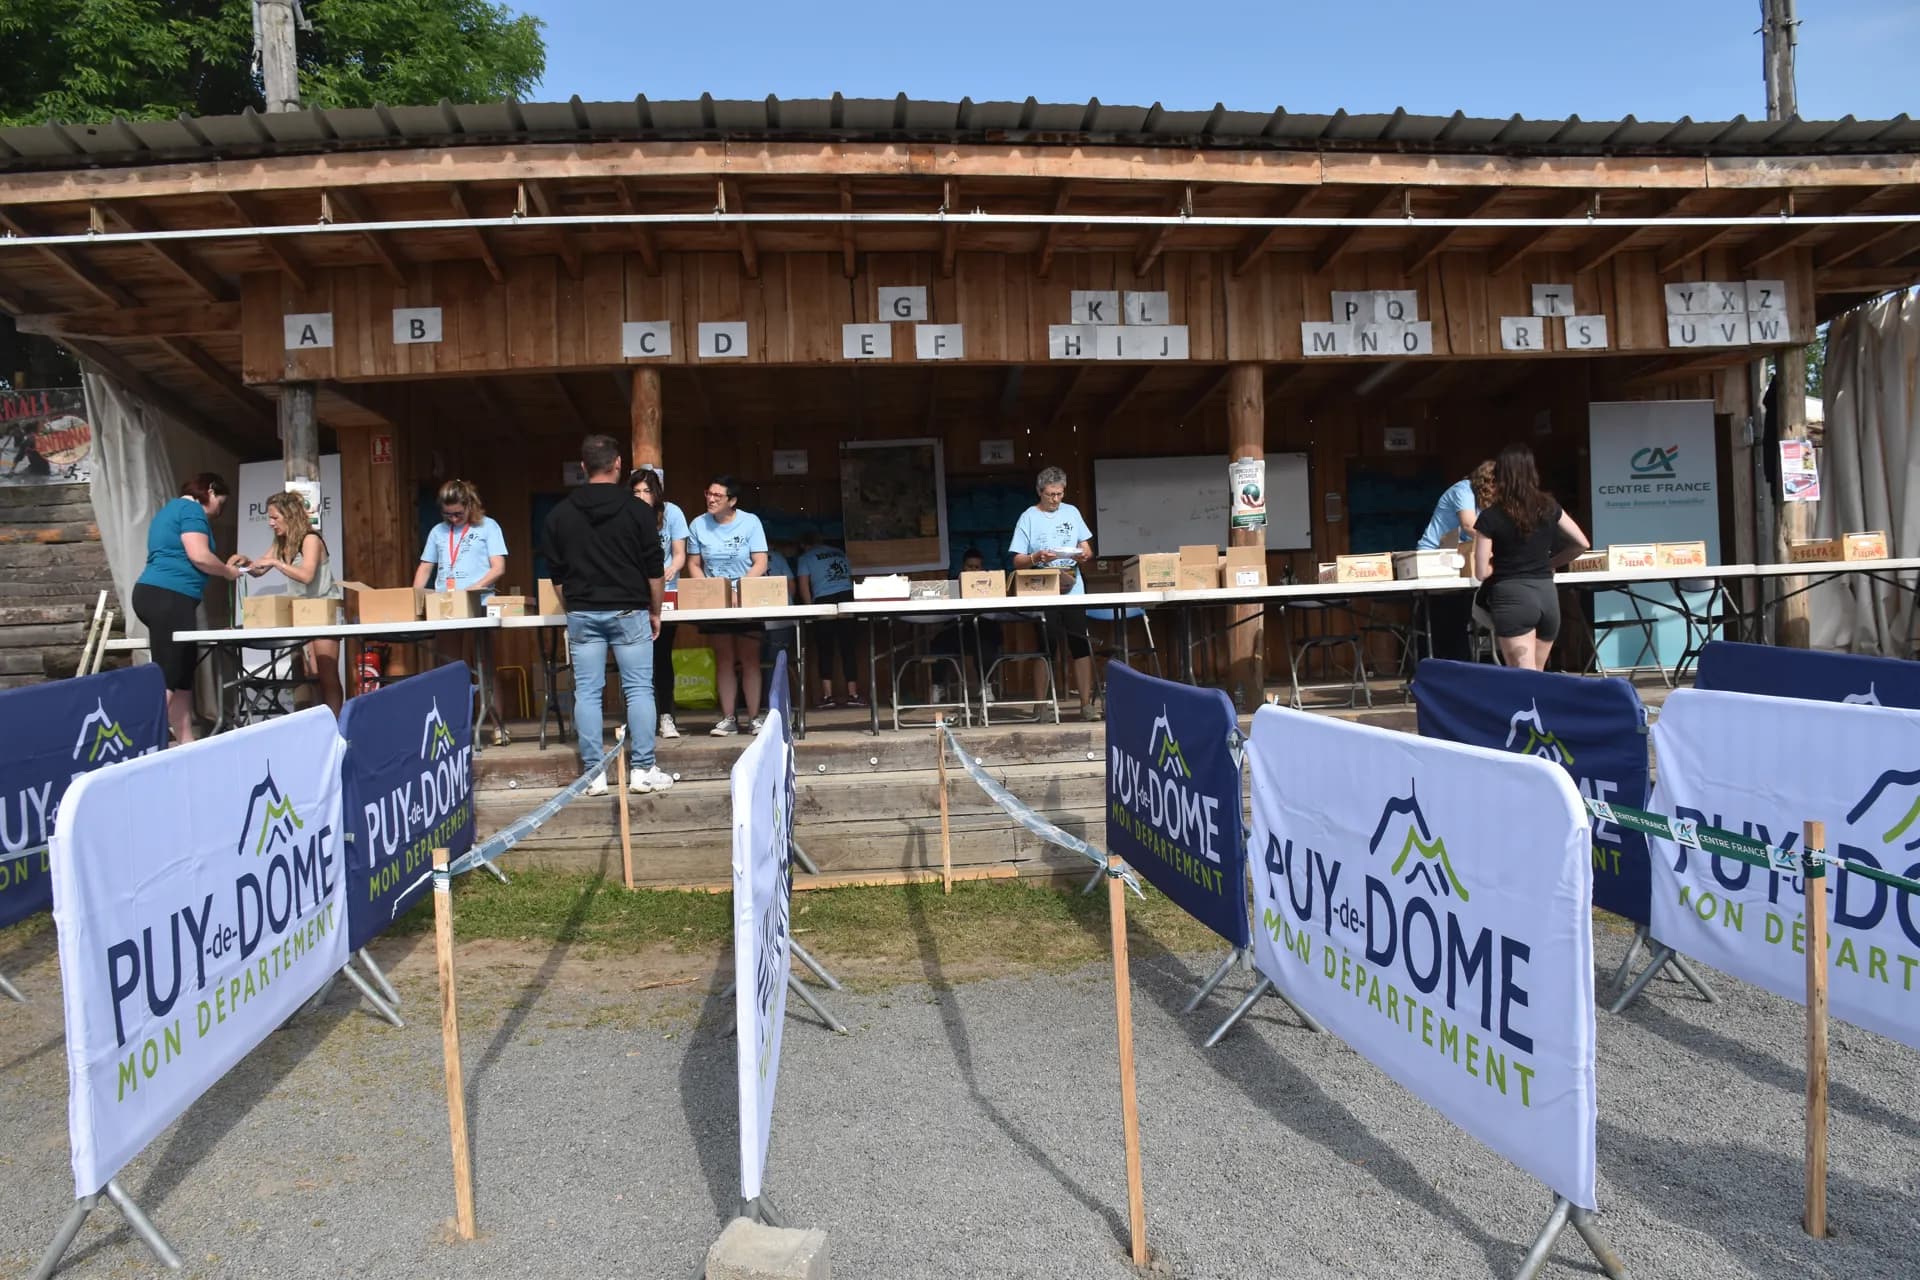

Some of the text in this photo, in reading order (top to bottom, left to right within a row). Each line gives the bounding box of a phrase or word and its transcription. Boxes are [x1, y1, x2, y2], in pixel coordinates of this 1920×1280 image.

[894, 297, 911, 317] G
[1545, 294, 1558, 313] T
[1680, 293, 1693, 311] Y
[1722, 291, 1736, 310] X
[1760, 289, 1771, 308] Z
[1088, 301, 1102, 320] K
[1141, 302, 1152, 321] L
[1346, 302, 1358, 321] P
[1387, 301, 1404, 321] Q
[300, 325, 317, 344] A
[410, 319, 425, 339] B
[1516, 327, 1529, 346] R
[1580, 326, 1591, 345] S
[1681, 325, 1696, 343] U
[1721, 324, 1736, 343] V
[1758, 321, 1778, 340] W
[640, 332, 655, 353] C
[715, 333, 732, 353] D
[861, 335, 874, 355] E
[935, 335, 946, 355] F
[1065, 336, 1080, 356] H
[1117, 336, 1122, 356] I
[1160, 336, 1168, 356] J
[1314, 332, 1335, 351] M
[1361, 332, 1378, 351] N
[1404, 332, 1418, 351] O
[1598, 482, 1711, 495] CENTRE FRANCE
[1614, 811, 1640, 824] CENTRE
[1640, 817, 1670, 833] FRANCE
[1699, 834, 1729, 849] CENTRE
[1730, 842, 1766, 858] FRANCE
[1112, 801, 1223, 896] MON DÉPARTEMENT
[369, 859, 400, 901] MON
[117, 901, 335, 1102] MON DÉPARTEMENT
[1263, 907, 1535, 1108] MON DÉPARTEMENT
